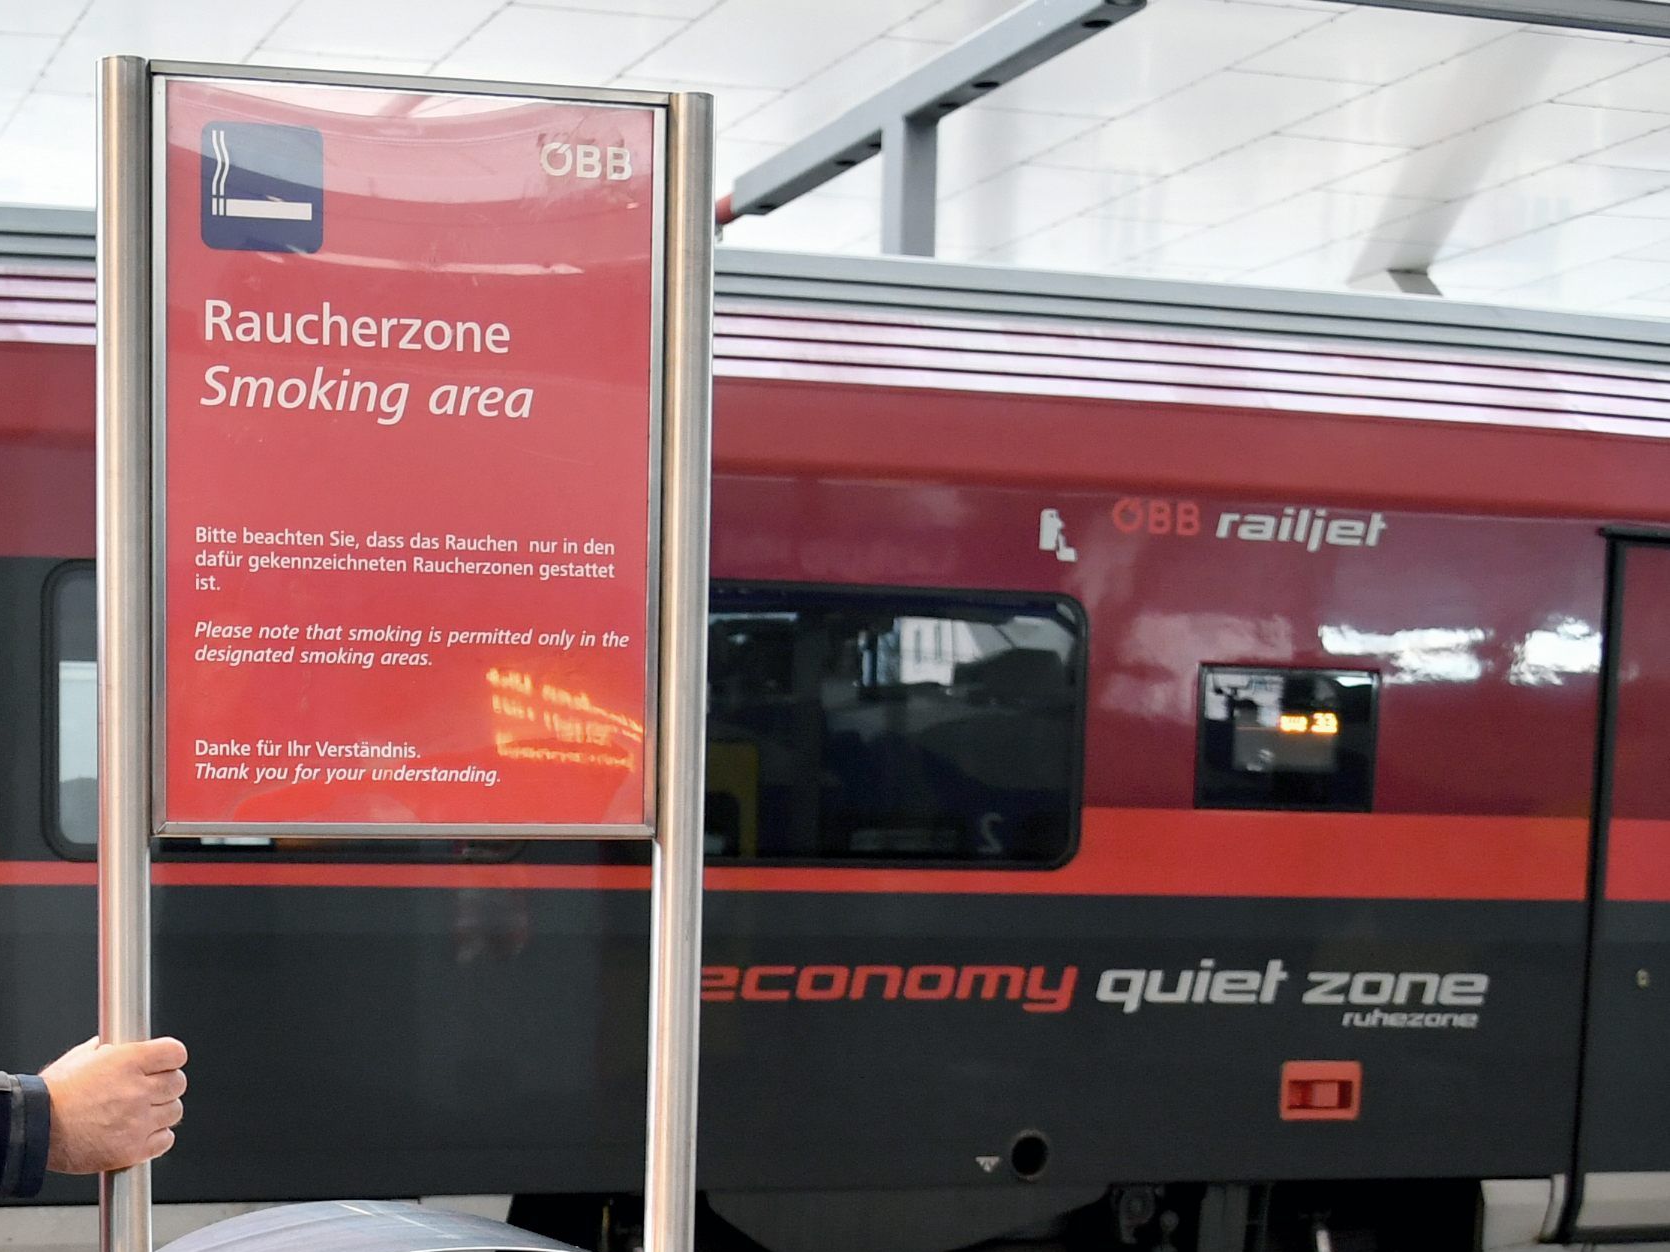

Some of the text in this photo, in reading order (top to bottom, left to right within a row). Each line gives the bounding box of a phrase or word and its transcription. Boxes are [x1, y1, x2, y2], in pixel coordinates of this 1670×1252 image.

[540, 140, 633, 181] ÖBB
[204, 299, 511, 354] Raucherzone
[200, 365, 534, 425] Smoking area
[1111, 497, 1387, 552] ÖBB railjet
[195, 526, 615, 556] Bitte beachten Sie, dass das Rauchen nur in den
[195, 550, 615, 581] dafür gekennzeichneten Raucherzonen gestattet
[195, 573, 221, 591] ist.
[195, 620, 630, 651] Please note that smoking is permitted only in the
[195, 645, 433, 669] designated smoking areas.
[195, 739, 421, 759] Danke für Ihr Verständnis.
[195, 763, 501, 786] Thank you for your understanding.
[701, 958, 1490, 1013] economy quiet zone
[1341, 1008, 1479, 1028] ruhezone
